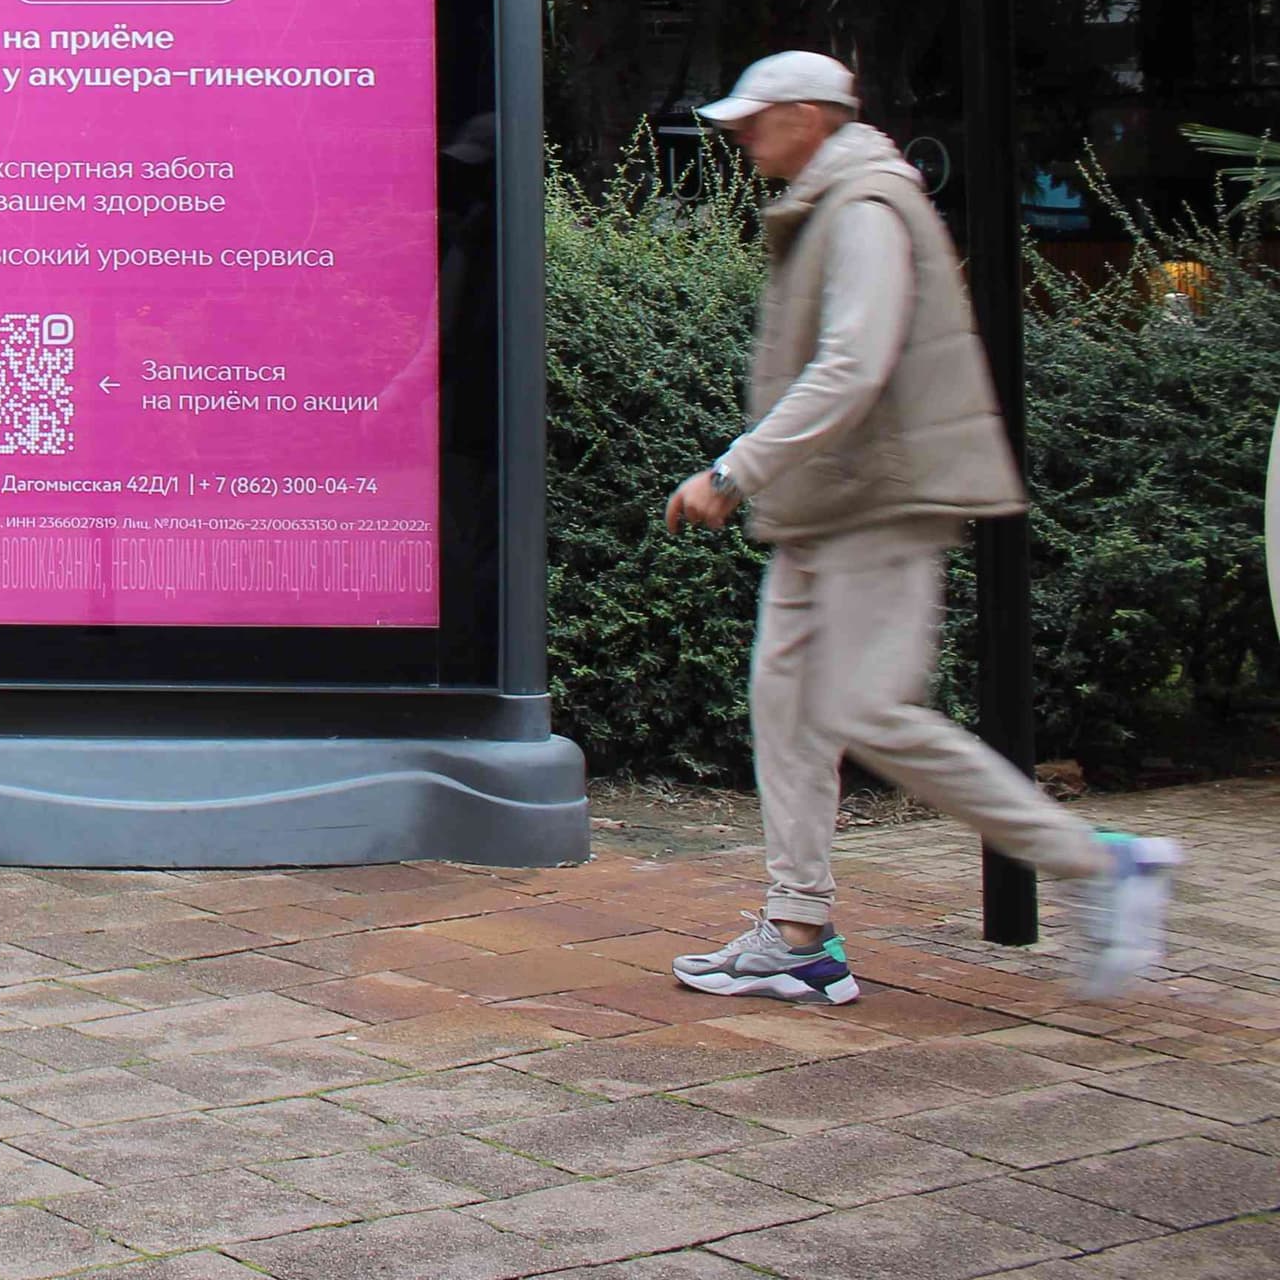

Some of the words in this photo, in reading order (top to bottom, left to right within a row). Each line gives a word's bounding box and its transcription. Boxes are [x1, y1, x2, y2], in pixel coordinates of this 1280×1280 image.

[3, 30, 41, 49] на
[50, 23, 175, 56] приёме
[2, 67, 21, 93] у
[28, 67, 375, 93] акушера-гинеколога
[140, 156, 234, 179] забота
[93, 194, 226, 217] здоровье
[97, 248, 213, 272] уровень
[220, 249, 334, 272] сервиса
[141, 359, 286, 382] Записаться
[141, 394, 172, 411] на
[180, 390, 259, 416] приём
[268, 395, 297, 411] по
[303, 395, 378, 415] акции
[0, 474, 122, 494] Дагомысская
[126, 475, 179, 497] 42Д/1
[230, 476, 279, 498] (862)
[282, 477, 378, 494] 300-04-74
[6, 516, 36, 529] ИНН
[339, 521, 356, 531] от
[112, 538, 207, 599] НЕОБХОДИМА
[212, 539, 318, 600] КОНСУЛЬТАЦИЯ
[323, 540, 433, 600] СПЕЦИАЛИСТОВ
